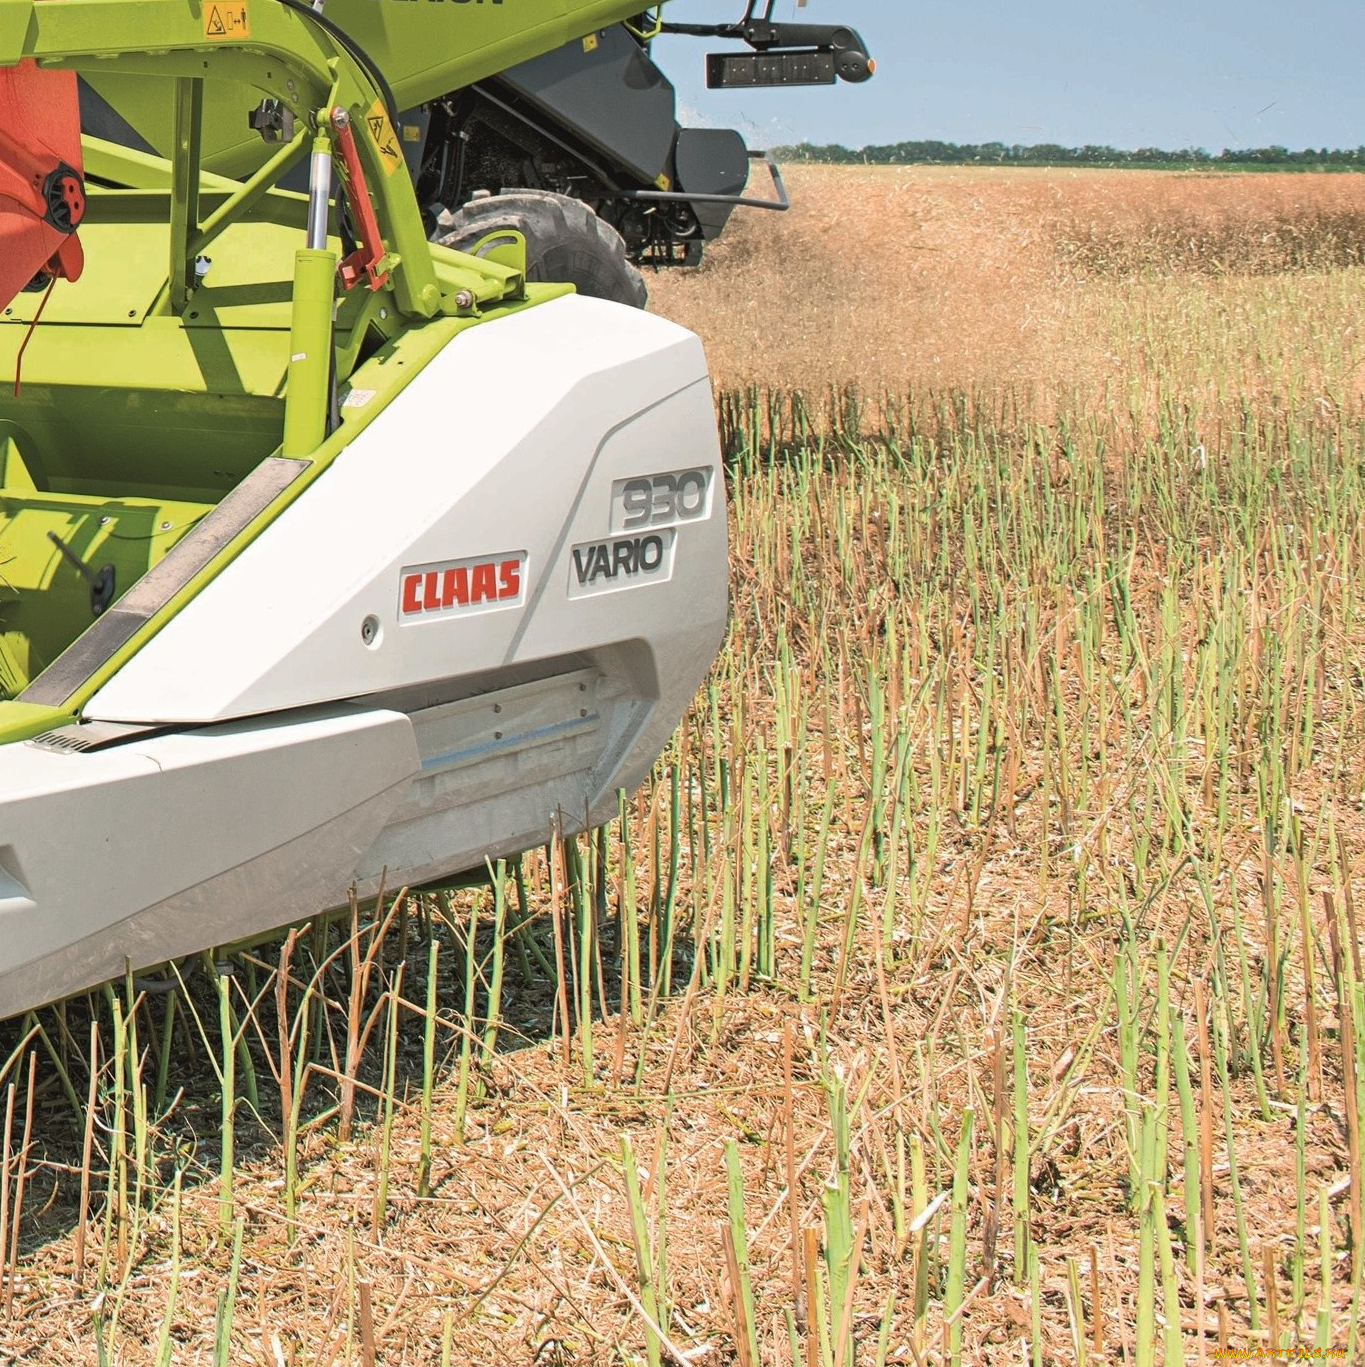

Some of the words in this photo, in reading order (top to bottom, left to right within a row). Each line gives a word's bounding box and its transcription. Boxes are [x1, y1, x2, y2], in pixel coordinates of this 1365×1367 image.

[622, 471, 705, 528] 930
[402, 559, 520, 613] CLAAS
[573, 535, 663, 584] VARIO
